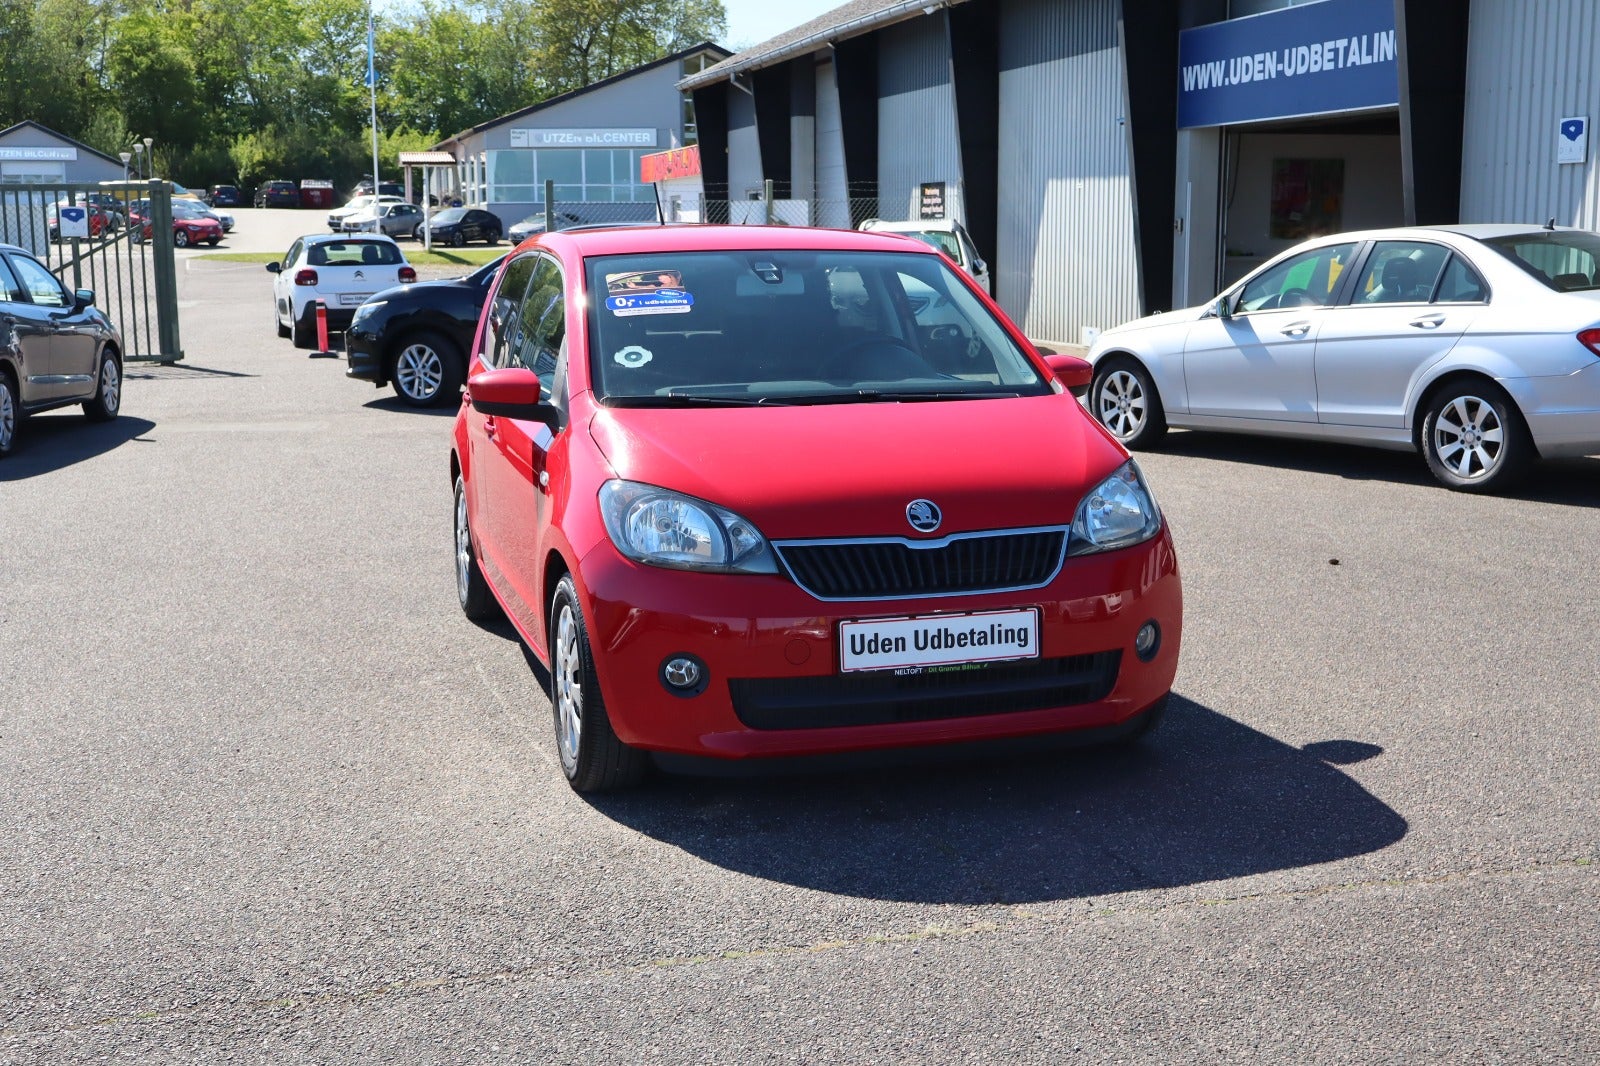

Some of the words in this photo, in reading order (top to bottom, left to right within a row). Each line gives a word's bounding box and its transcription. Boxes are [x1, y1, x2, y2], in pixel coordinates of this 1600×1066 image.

[1182, 29, 1398, 92] WWW.UDEN-UDBETALIN
[850, 633, 906, 656] Uden
[913, 623, 1029, 651] Udbetaling
[894, 667, 923, 676] NELTOFT
